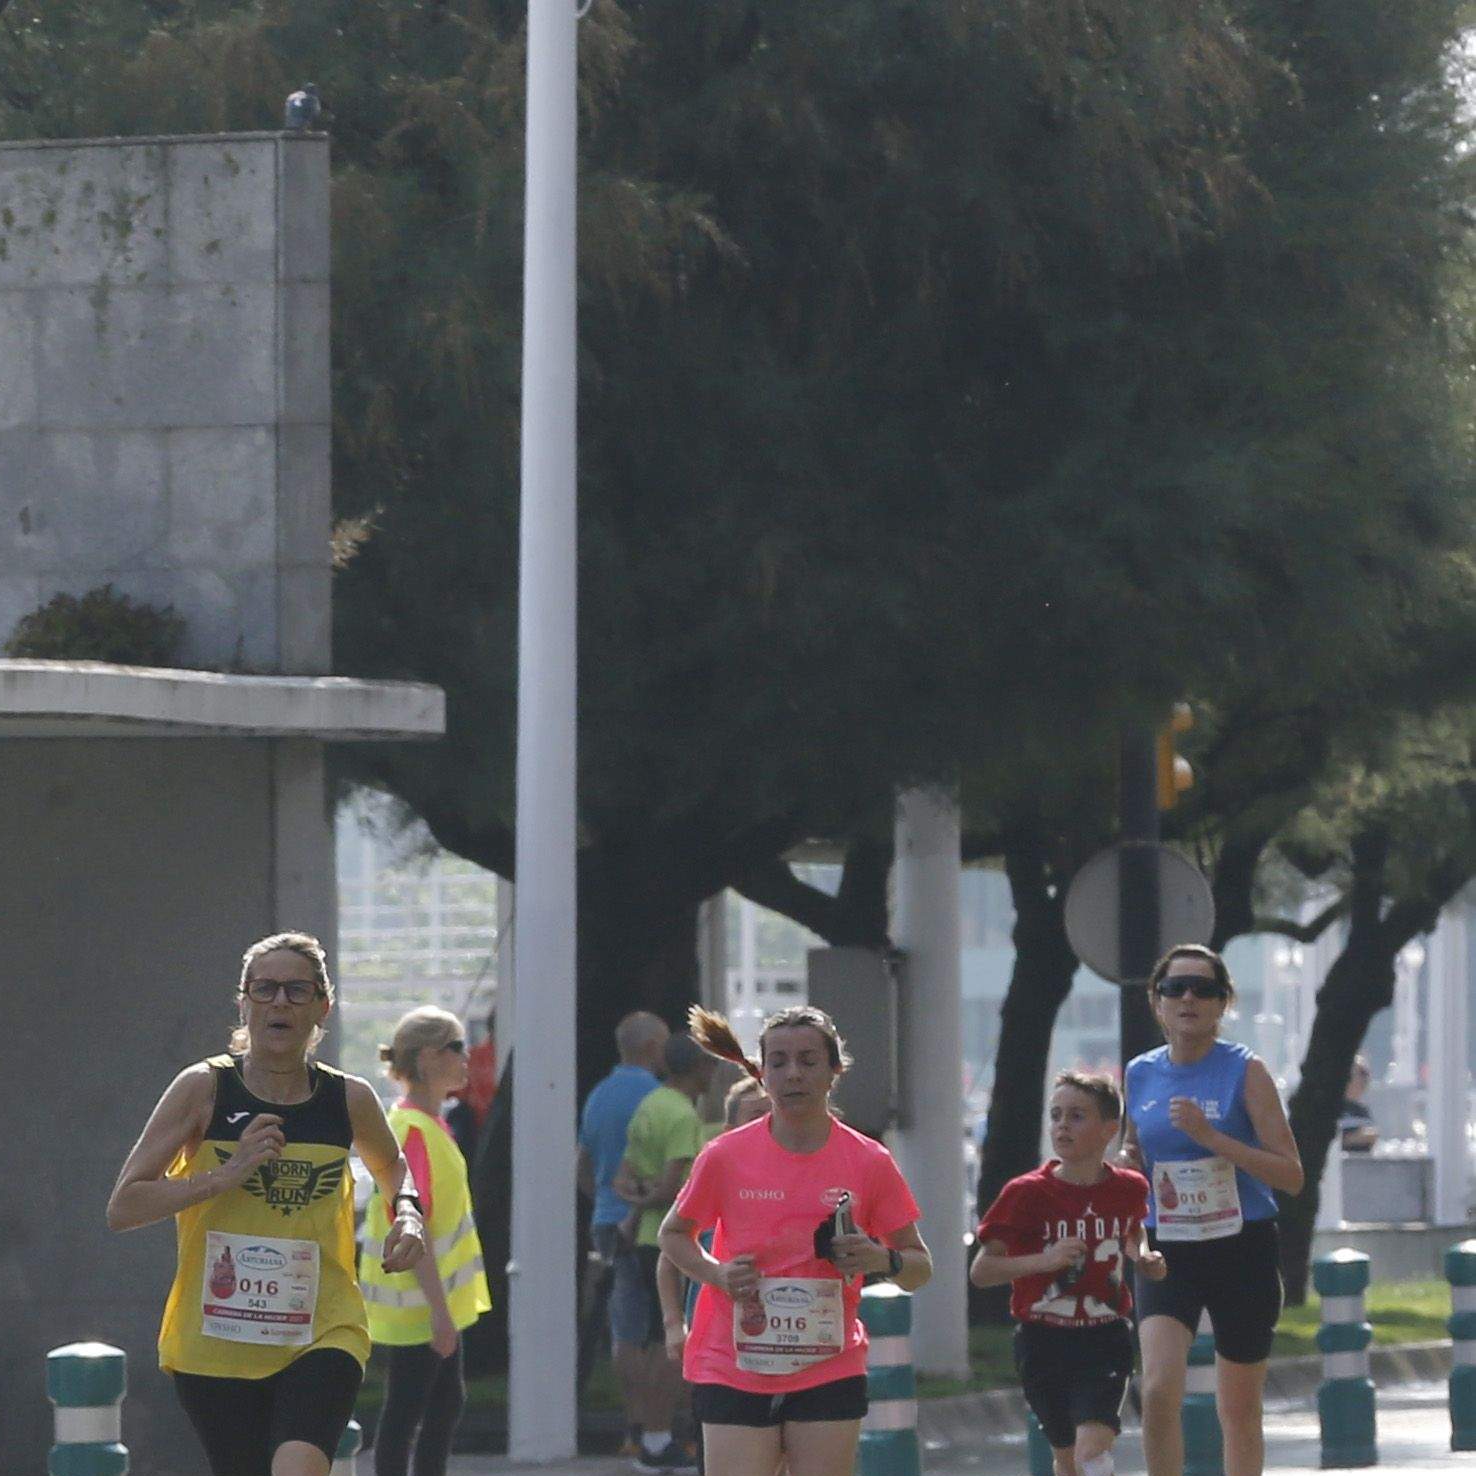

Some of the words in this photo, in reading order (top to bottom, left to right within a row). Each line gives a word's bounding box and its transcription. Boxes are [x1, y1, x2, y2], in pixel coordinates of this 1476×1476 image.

[270, 1161, 309, 1176] BORN
[268, 1187, 308, 1204] RUN
[739, 1189, 785, 1200] OYSHO
[1180, 1190, 1208, 1205] 016
[241, 1253, 283, 1266] ASTURIANA
[240, 1278, 279, 1296] 016
[248, 1299, 267, 1309] 543
[770, 1316, 807, 1330] 016
